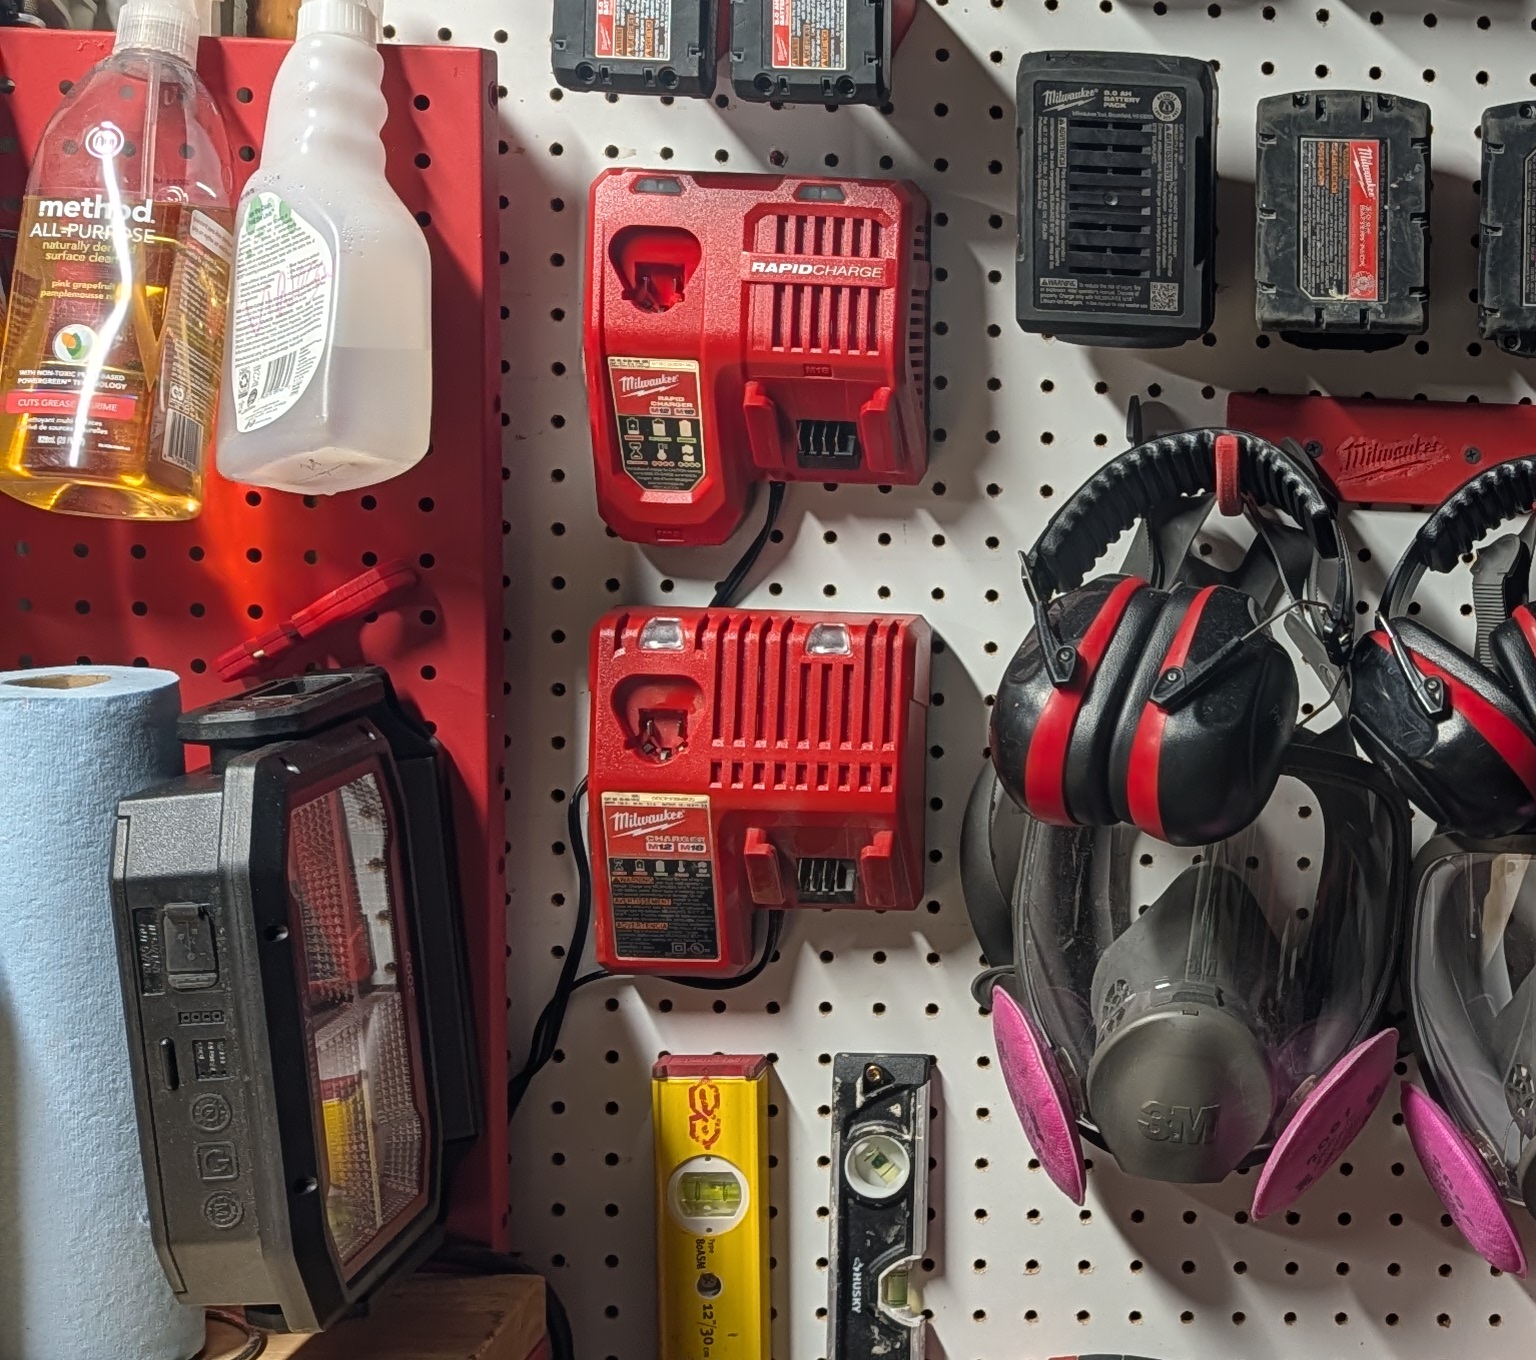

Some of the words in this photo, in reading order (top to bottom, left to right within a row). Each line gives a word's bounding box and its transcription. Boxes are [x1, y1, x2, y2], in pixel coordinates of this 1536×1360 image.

[1042, 88, 1096, 106] Milwaukee
[1104, 96, 1140, 104] BATTERY
[1358, 145, 1376, 199] Milwaukee
[29, 222, 156, 244] ALL-PURPSE
[43, 240, 91, 254] naturally
[93, 241, 136, 255] derd
[45, 250, 85, 262] surface
[751, 262, 884, 278] RAPIDCHARGE
[52, 280, 71, 289] pink
[619, 374, 679, 392] Milwaukee
[18, 399, 39, 407] CUTS
[1341, 437, 1439, 470] Milwaukee
[609, 809, 685, 831] Milwaukee
[648, 843, 673, 851] M12
[680, 844, 705, 852] M18
[1136, 1099, 1220, 1145] 3M
[708, 1238, 716, 1254] Type
[852, 1272, 862, 1314] HUSKY
[703, 1346, 711, 1358] cm
